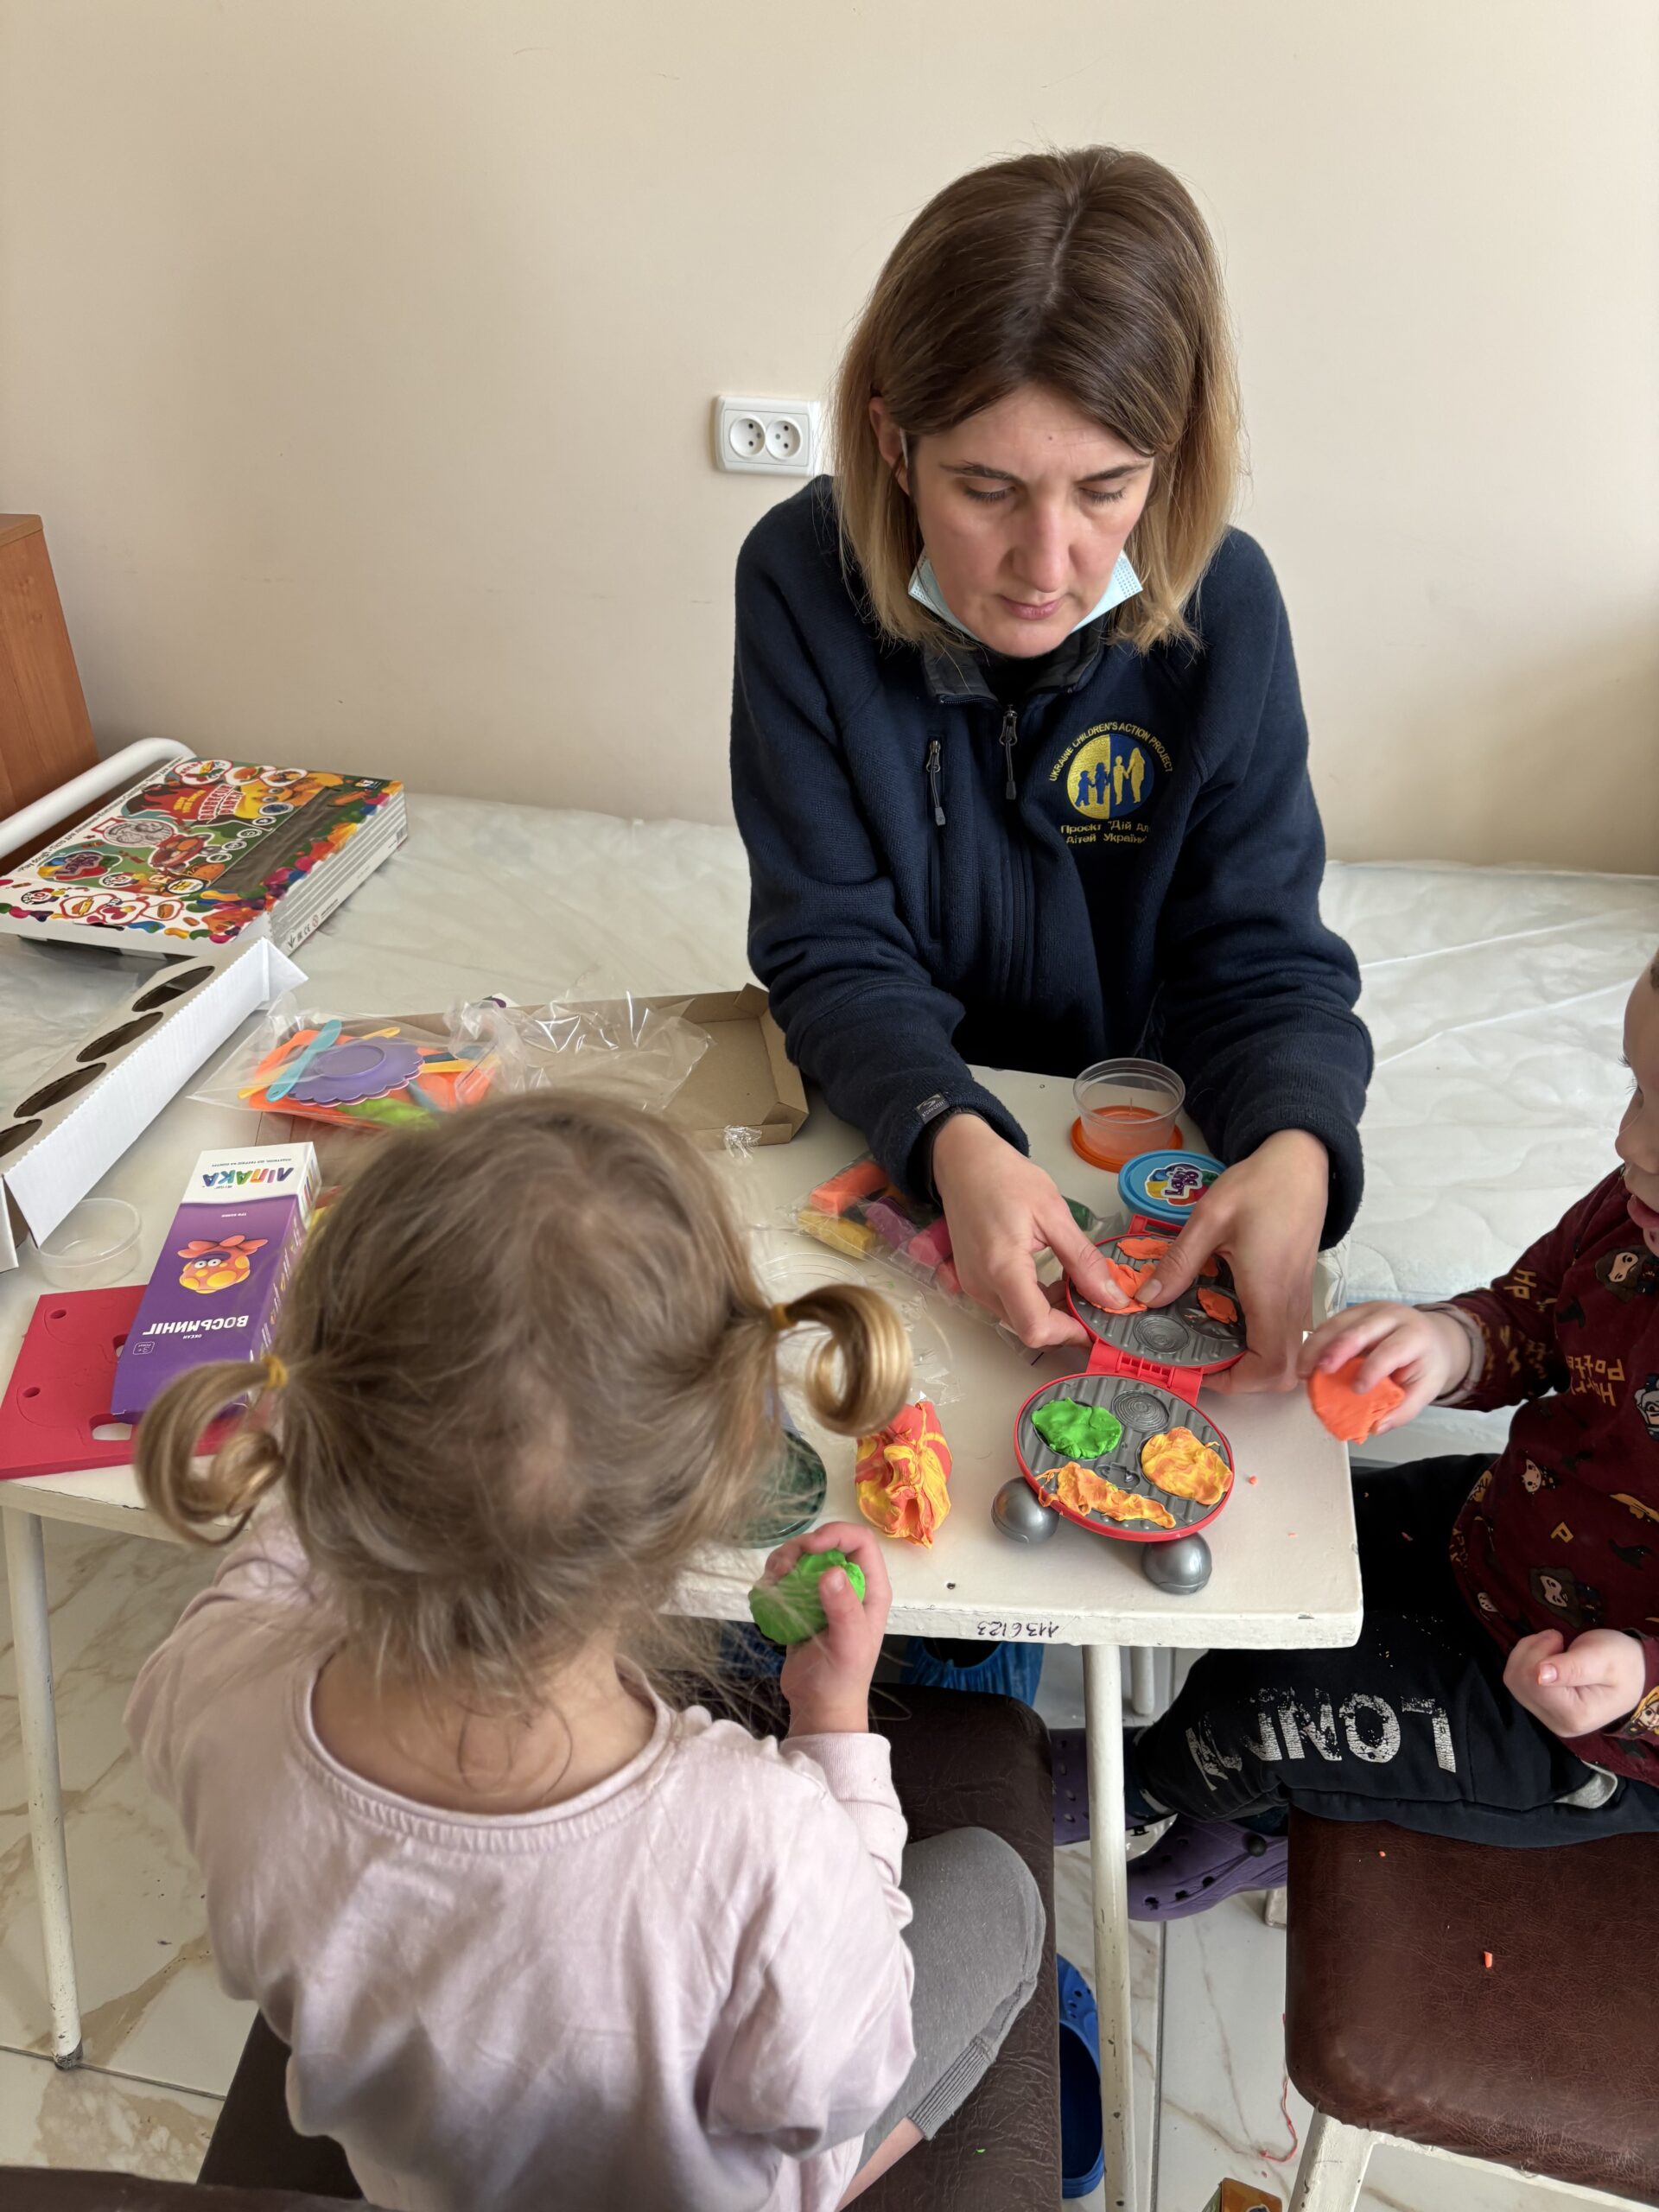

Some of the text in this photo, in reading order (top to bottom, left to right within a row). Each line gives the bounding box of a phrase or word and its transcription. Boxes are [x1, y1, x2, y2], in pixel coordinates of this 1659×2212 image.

[1049, 721, 1173, 782] UKRAINE CHILDREN'S ACTION PROJECT
[1136, 823, 1149, 833] дл
[202, 1167, 294, 1187] ЛІПАКА
[142, 1315, 249, 1336] ВОСЬМИНІГ
[1565, 1354, 1625, 1382] Potte
